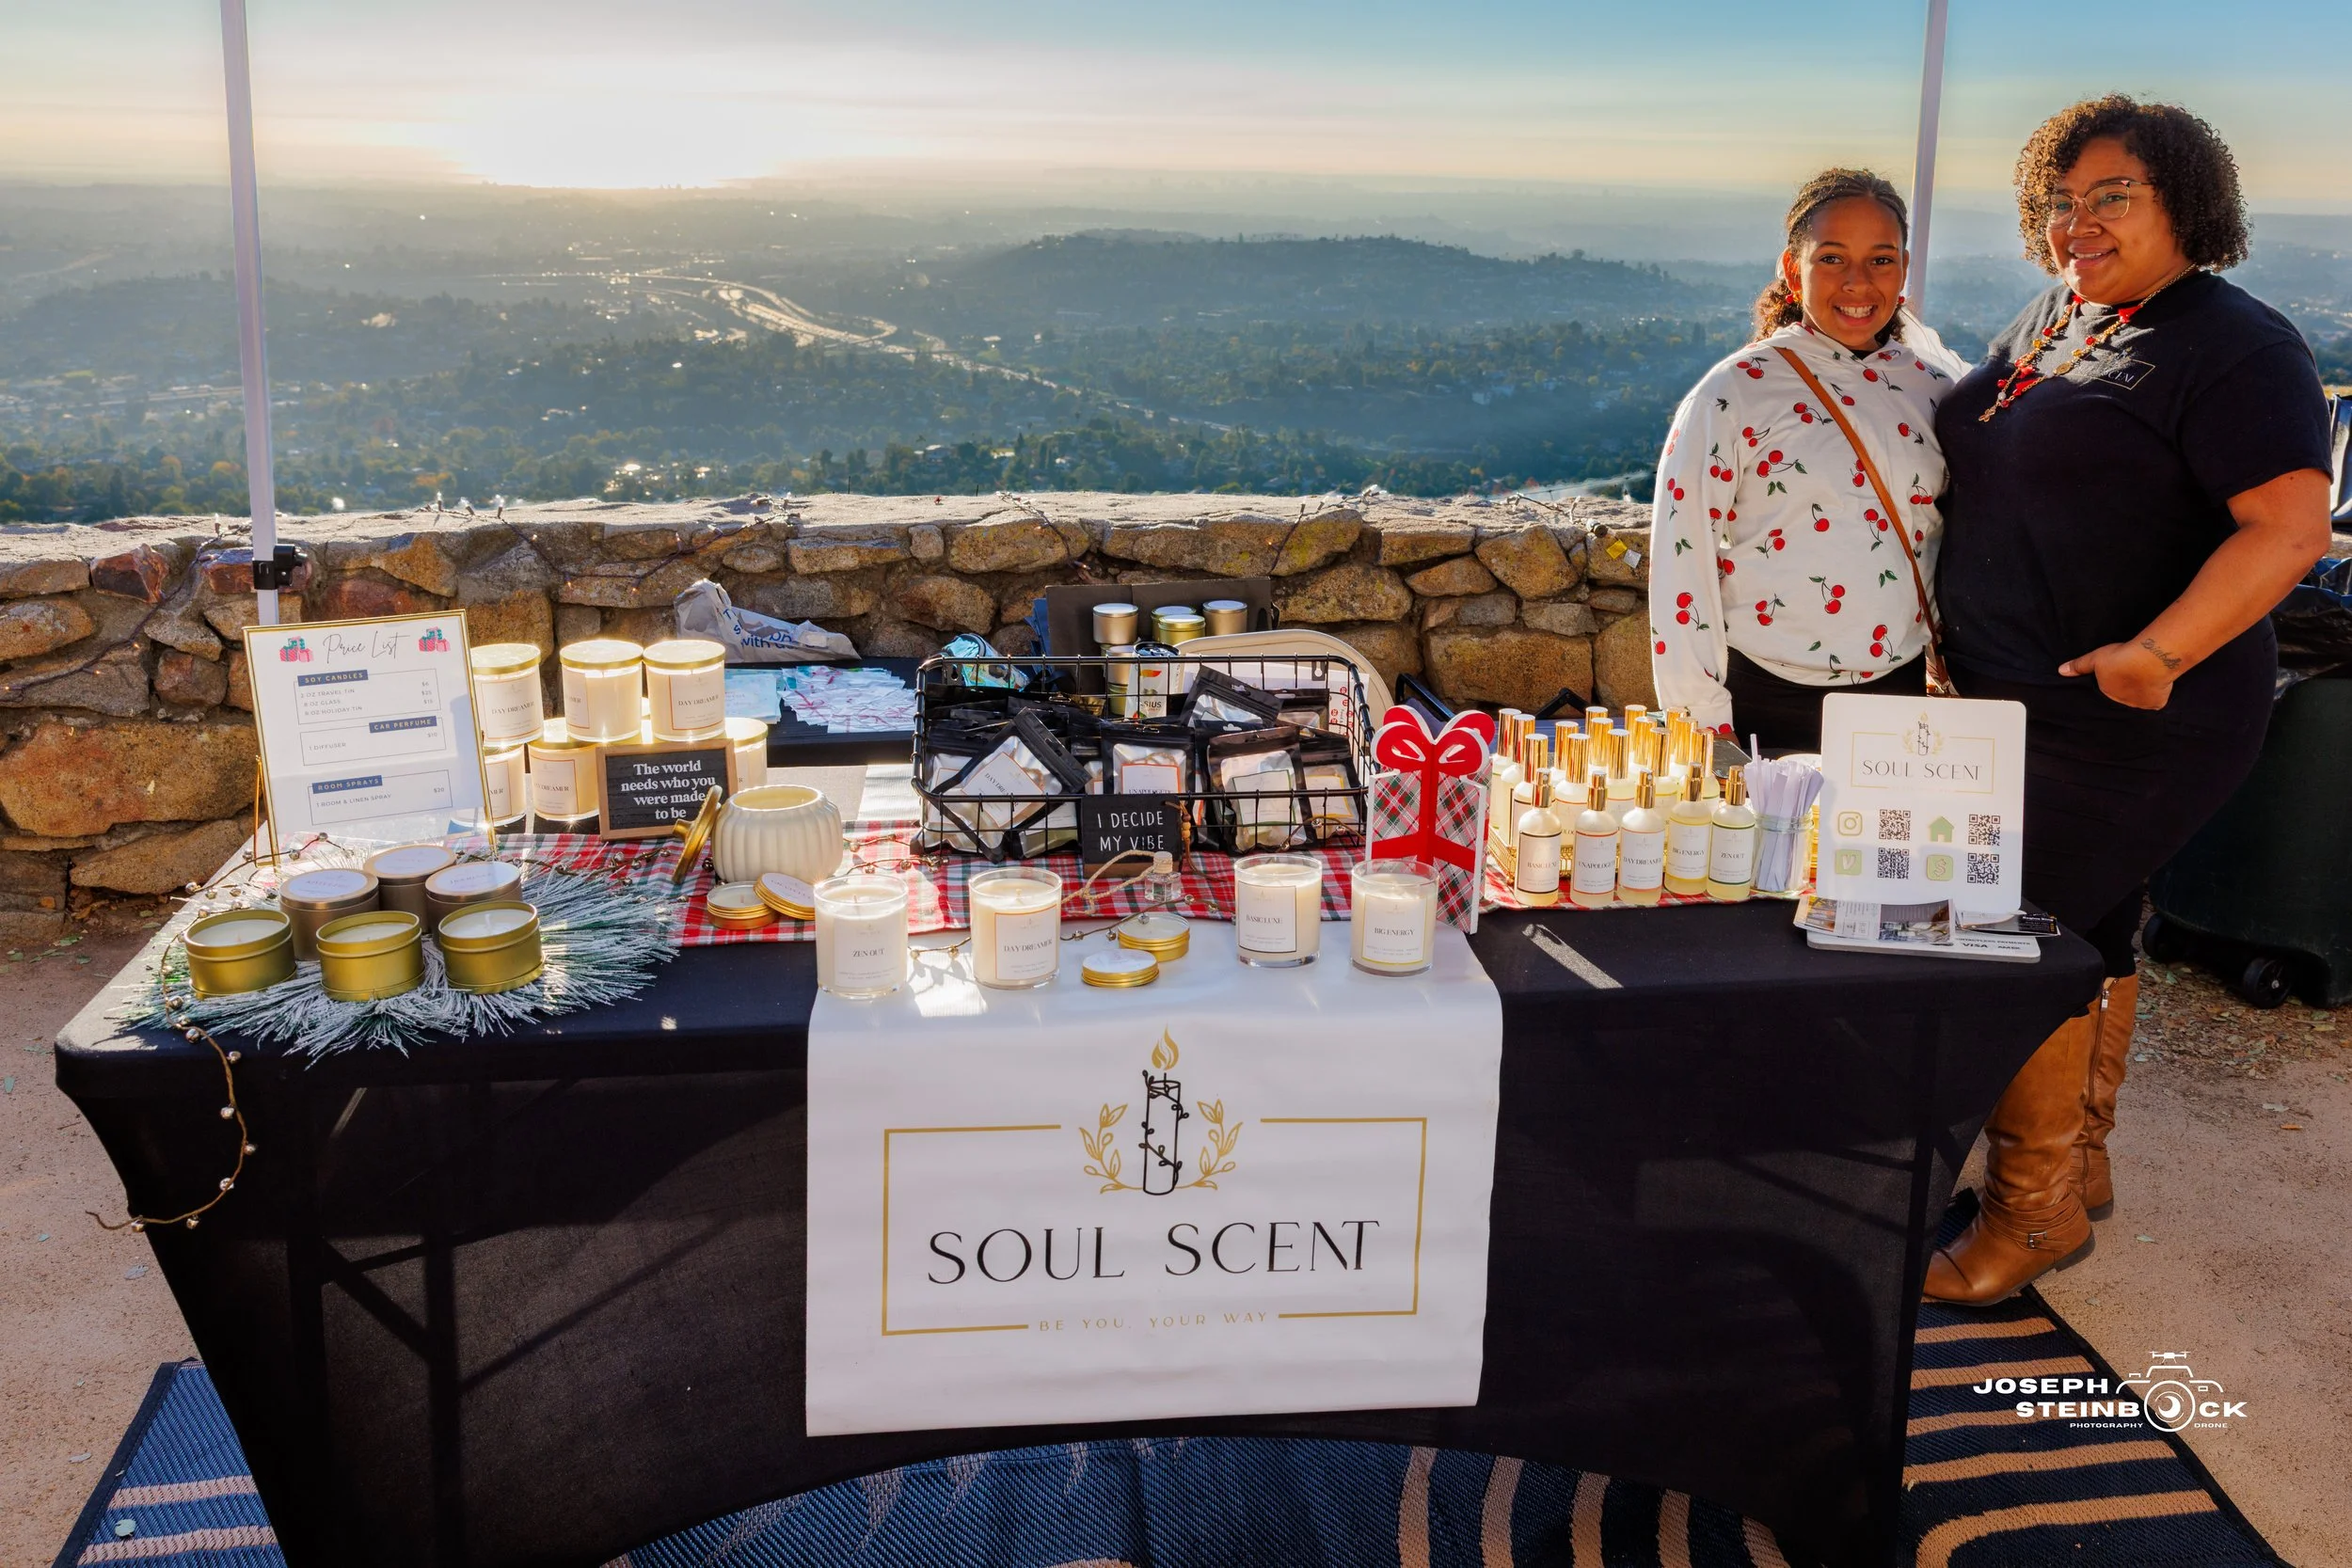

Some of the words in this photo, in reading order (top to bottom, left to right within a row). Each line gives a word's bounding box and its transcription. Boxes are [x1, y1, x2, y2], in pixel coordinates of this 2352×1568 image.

[323, 633, 366, 664] Price
[372, 630, 410, 659] List
[304, 675, 322, 684] SOY
[326, 673, 363, 682] CANDLES
[318, 689, 342, 697] TRAVEL
[491, 706, 506, 715] DAY
[373, 721, 390, 730] CAR
[393, 719, 432, 729] PERFUME
[314, 742, 346, 751] DIFFUSER
[633, 763, 660, 776] The
[662, 760, 702, 773] world
[1862, 760, 1915, 778] SOUL
[1924, 762, 1982, 781] SCENT
[318, 782, 343, 791] ROOM
[346, 778, 379, 787] SPRAYS
[621, 778, 659, 792] needs
[660, 776, 691, 788] who
[691, 776, 716, 790] you
[984, 773, 997, 784] DAY
[371, 793, 391, 801] SPRAY
[633, 794, 668, 806] were
[671, 790, 707, 803] made
[655, 808, 669, 820] to
[671, 807, 687, 818] be
[1097, 814, 1102, 828] I
[1111, 811, 1164, 828] DECIDE
[1100, 835, 1121, 851] MY
[1130, 834, 1164, 851] VIBE
[1623, 856, 1636, 864] DAY
[1246, 914, 1263, 923] BASIC
[1022, 939, 1053, 952] DREAMER
[853, 949, 868, 958] ZEN
[869, 947, 885, 956] OUT
[928, 1226, 1125, 1285] SOUL
[1165, 1219, 1380, 1277] SCENT
[1040, 1320, 1064, 1332] BE
[1150, 1314, 1206, 1328] YOUR
[1223, 1311, 1267, 1324] WAY
